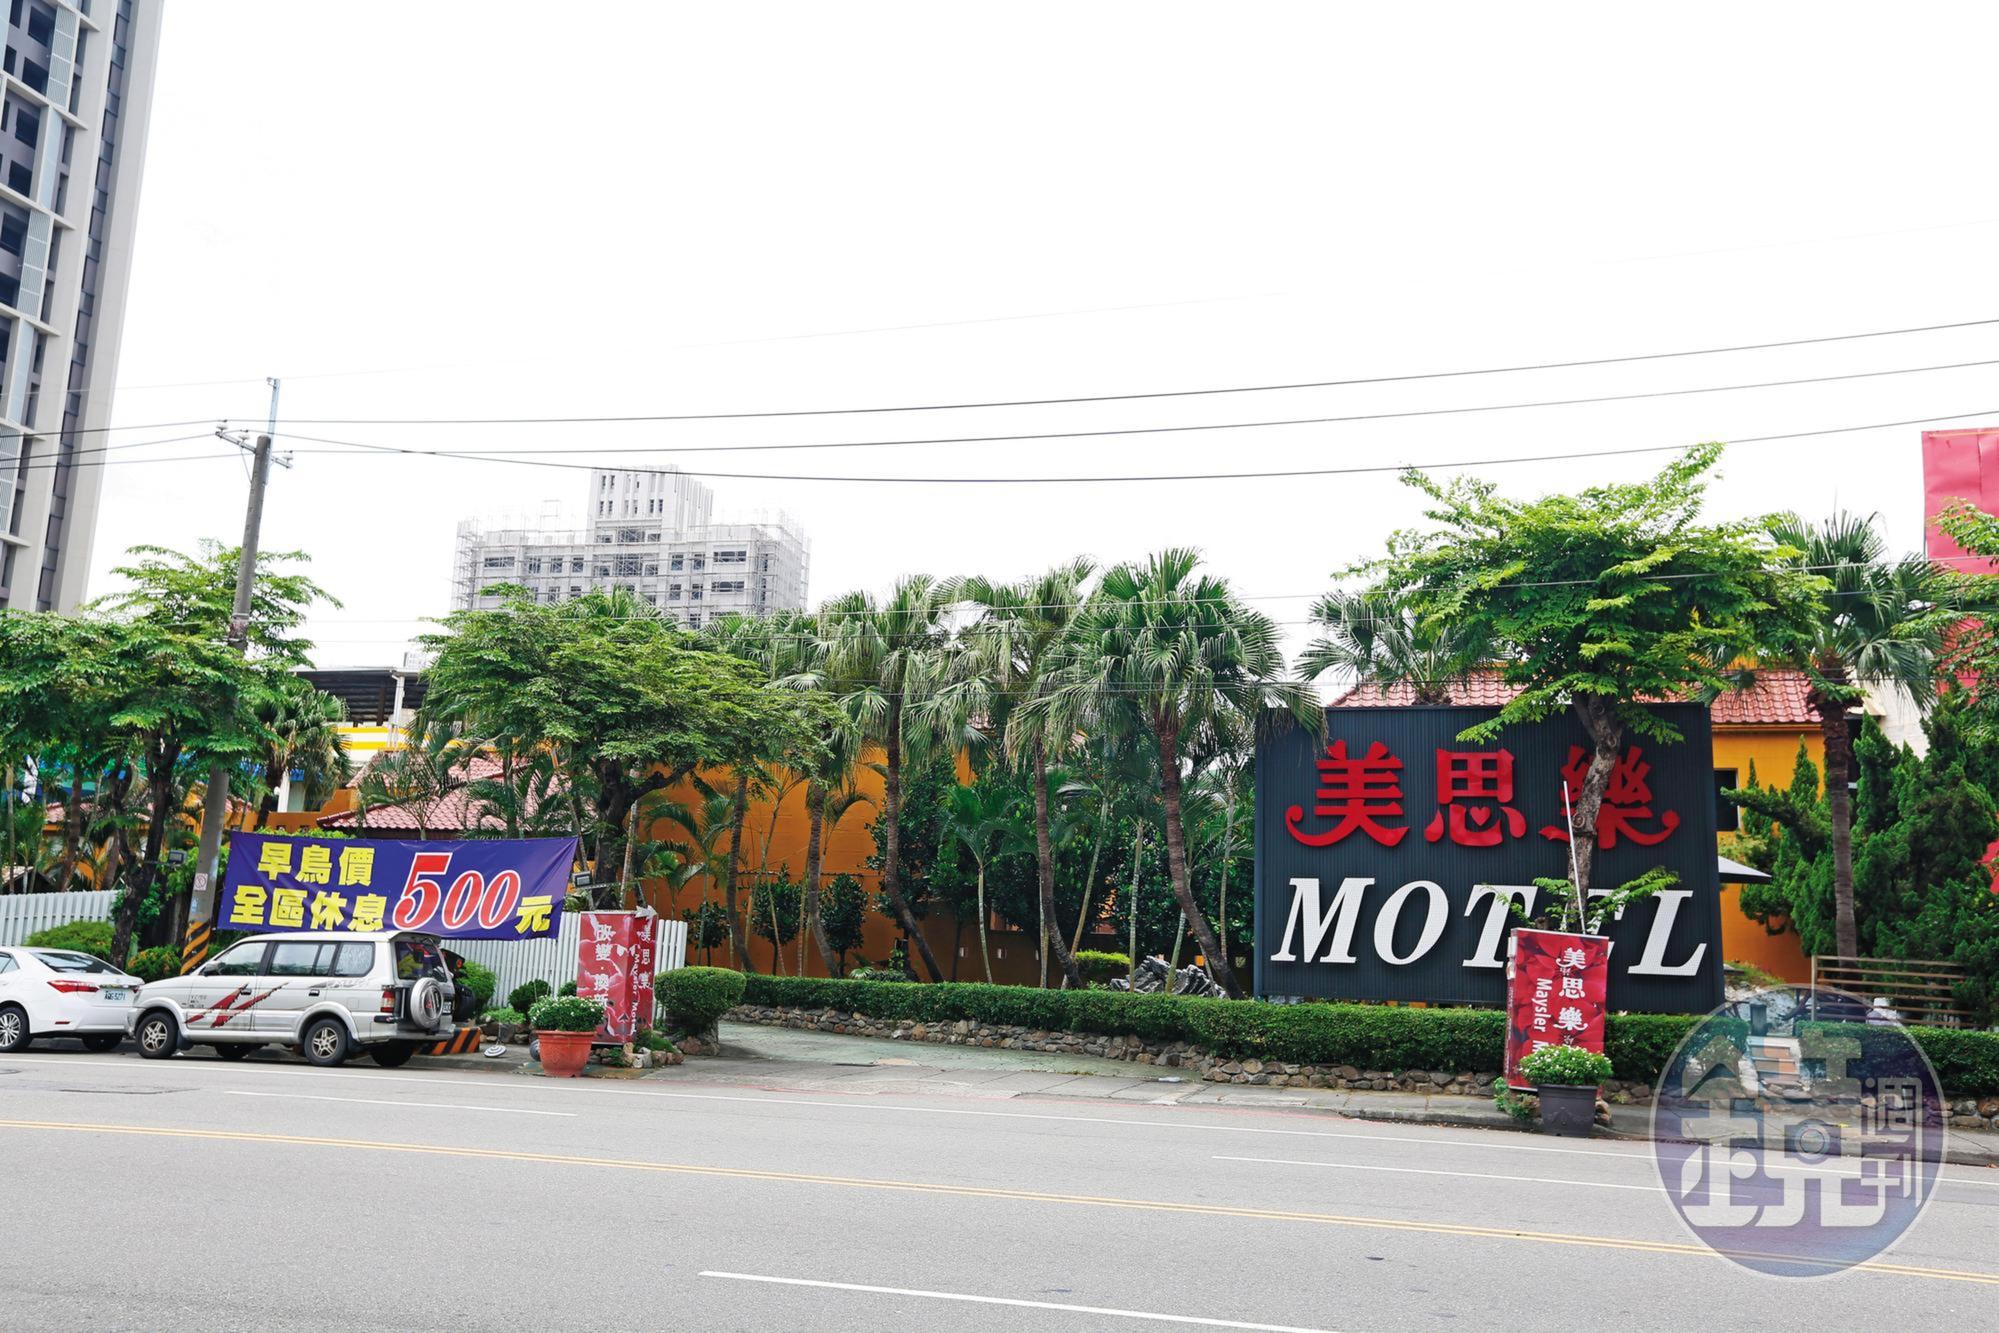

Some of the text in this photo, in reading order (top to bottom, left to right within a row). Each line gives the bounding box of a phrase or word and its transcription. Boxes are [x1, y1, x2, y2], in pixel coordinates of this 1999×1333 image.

[1285, 739, 1680, 849] 美思樂
[257, 841, 375, 886] 早鳥價
[229, 886, 387, 932] 全區休息
[1531, 977, 1552, 1033] Maysler
[1553, 947, 1588, 1031] 美思樂
